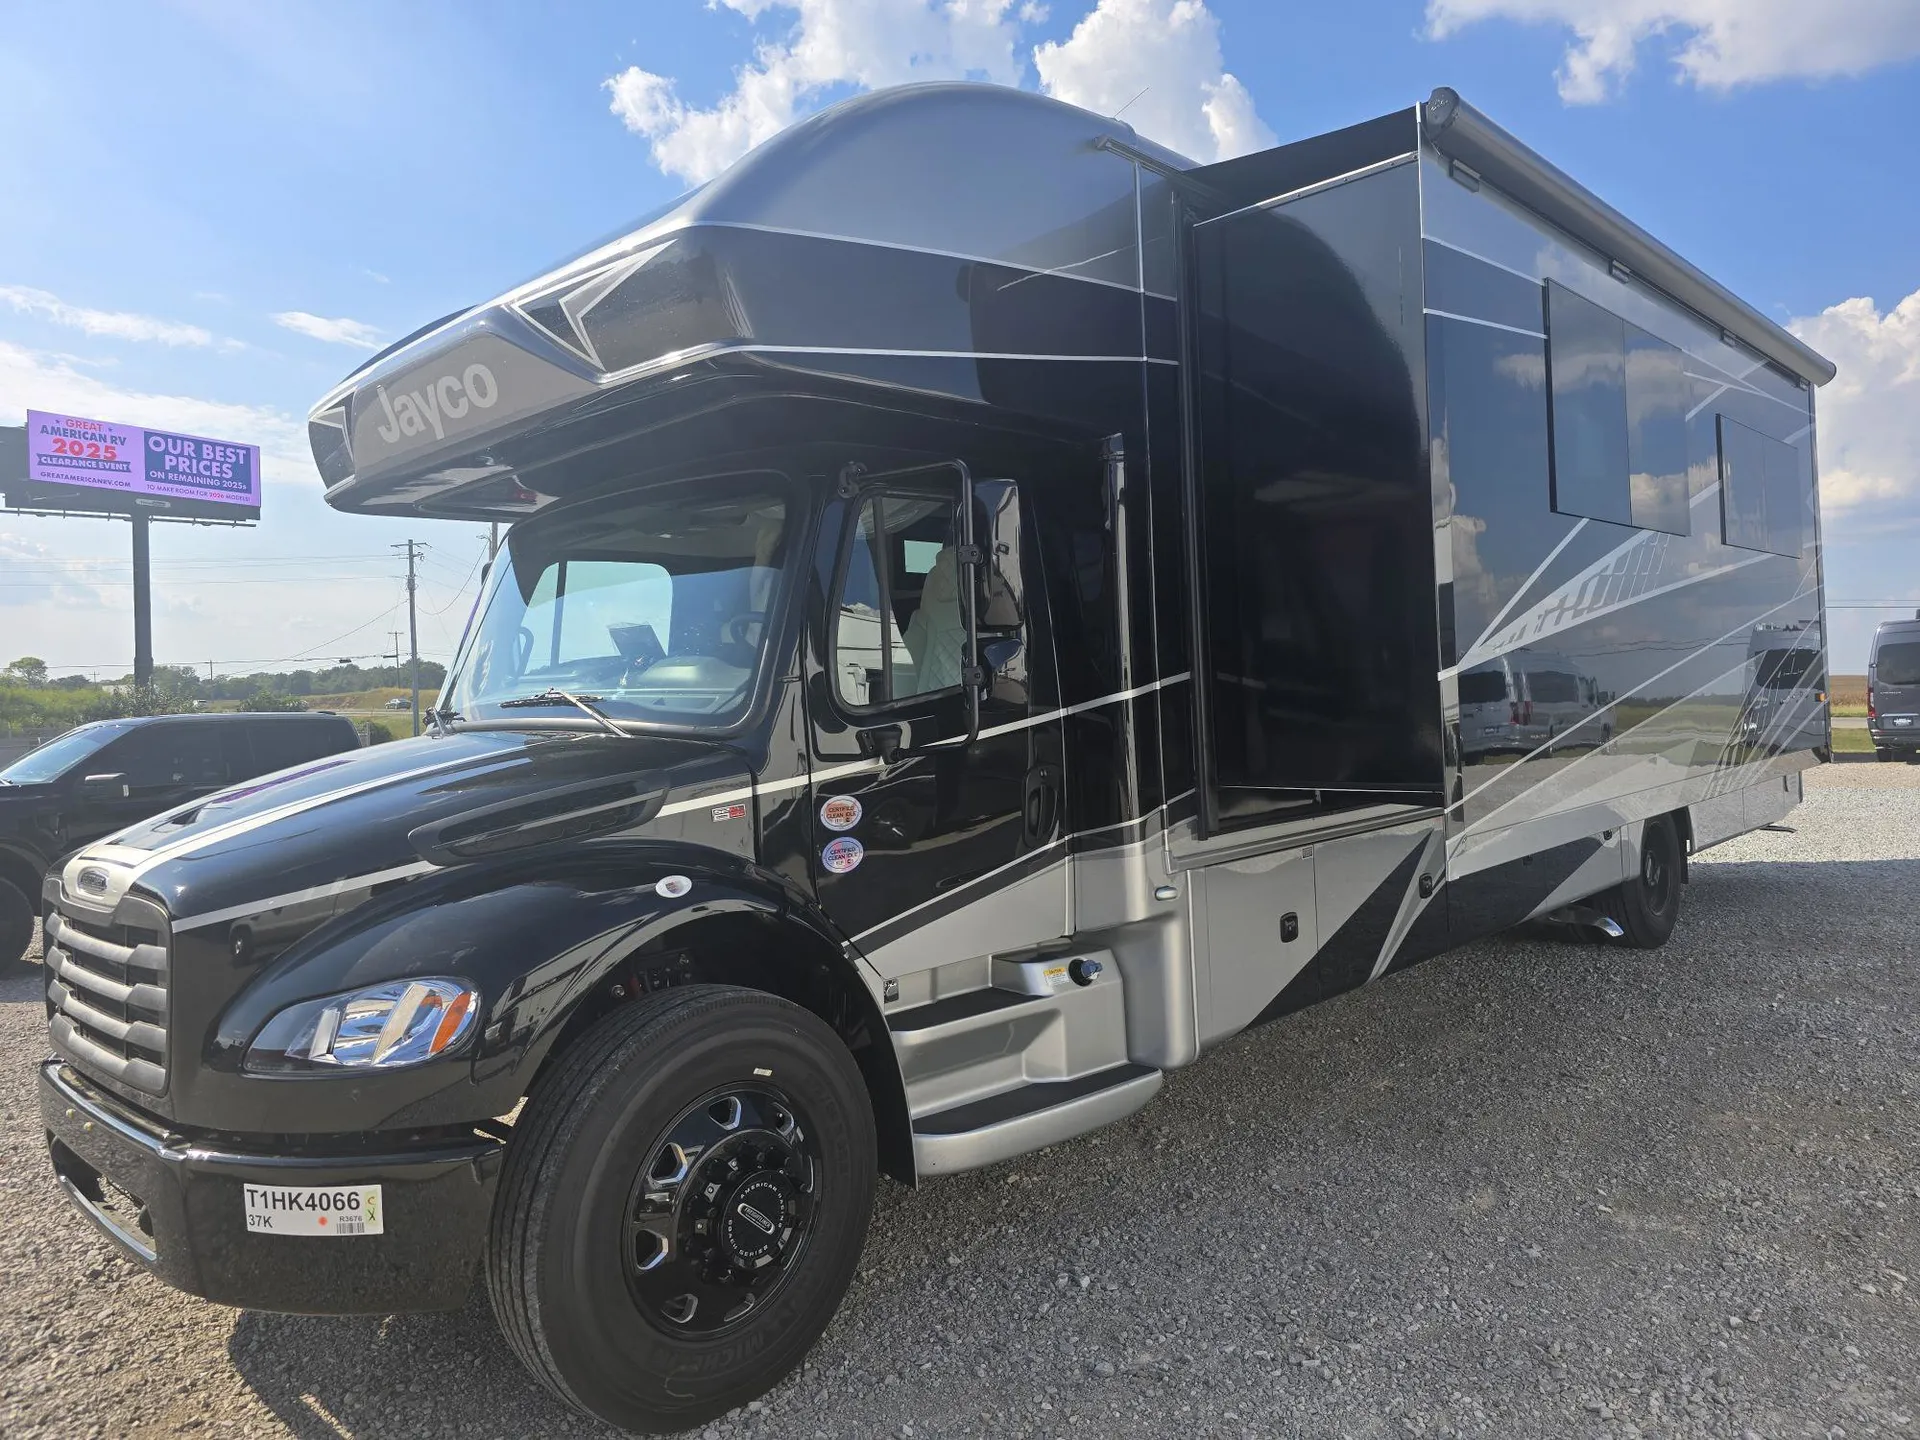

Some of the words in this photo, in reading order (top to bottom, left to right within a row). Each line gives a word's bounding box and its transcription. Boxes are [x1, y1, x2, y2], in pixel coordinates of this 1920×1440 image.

[376, 363, 499, 443] Jayco
[65, 419, 104, 432] GREAT
[40, 424, 107, 443] AMERICAN
[110, 435, 127, 446] RV
[52, 437, 117, 461] 2025
[148, 435, 197, 458] OUR
[202, 443, 247, 465] BEST
[40, 456, 97, 468] CLEARANCE
[98, 461, 128, 471] EVENT
[164, 454, 233, 479] PRICES
[40, 471, 131, 487] GREATAMERICANRV.COM
[149, 470, 165, 480] ON
[168, 472, 221, 487] REMAINING
[157, 485, 174, 493] MAKE
[175, 487, 196, 495] ROOM
[740, 1182, 778, 1199] AMERICAN
[246, 1188, 360, 1211] T1HK4066
[248, 1214, 273, 1229] 37K
